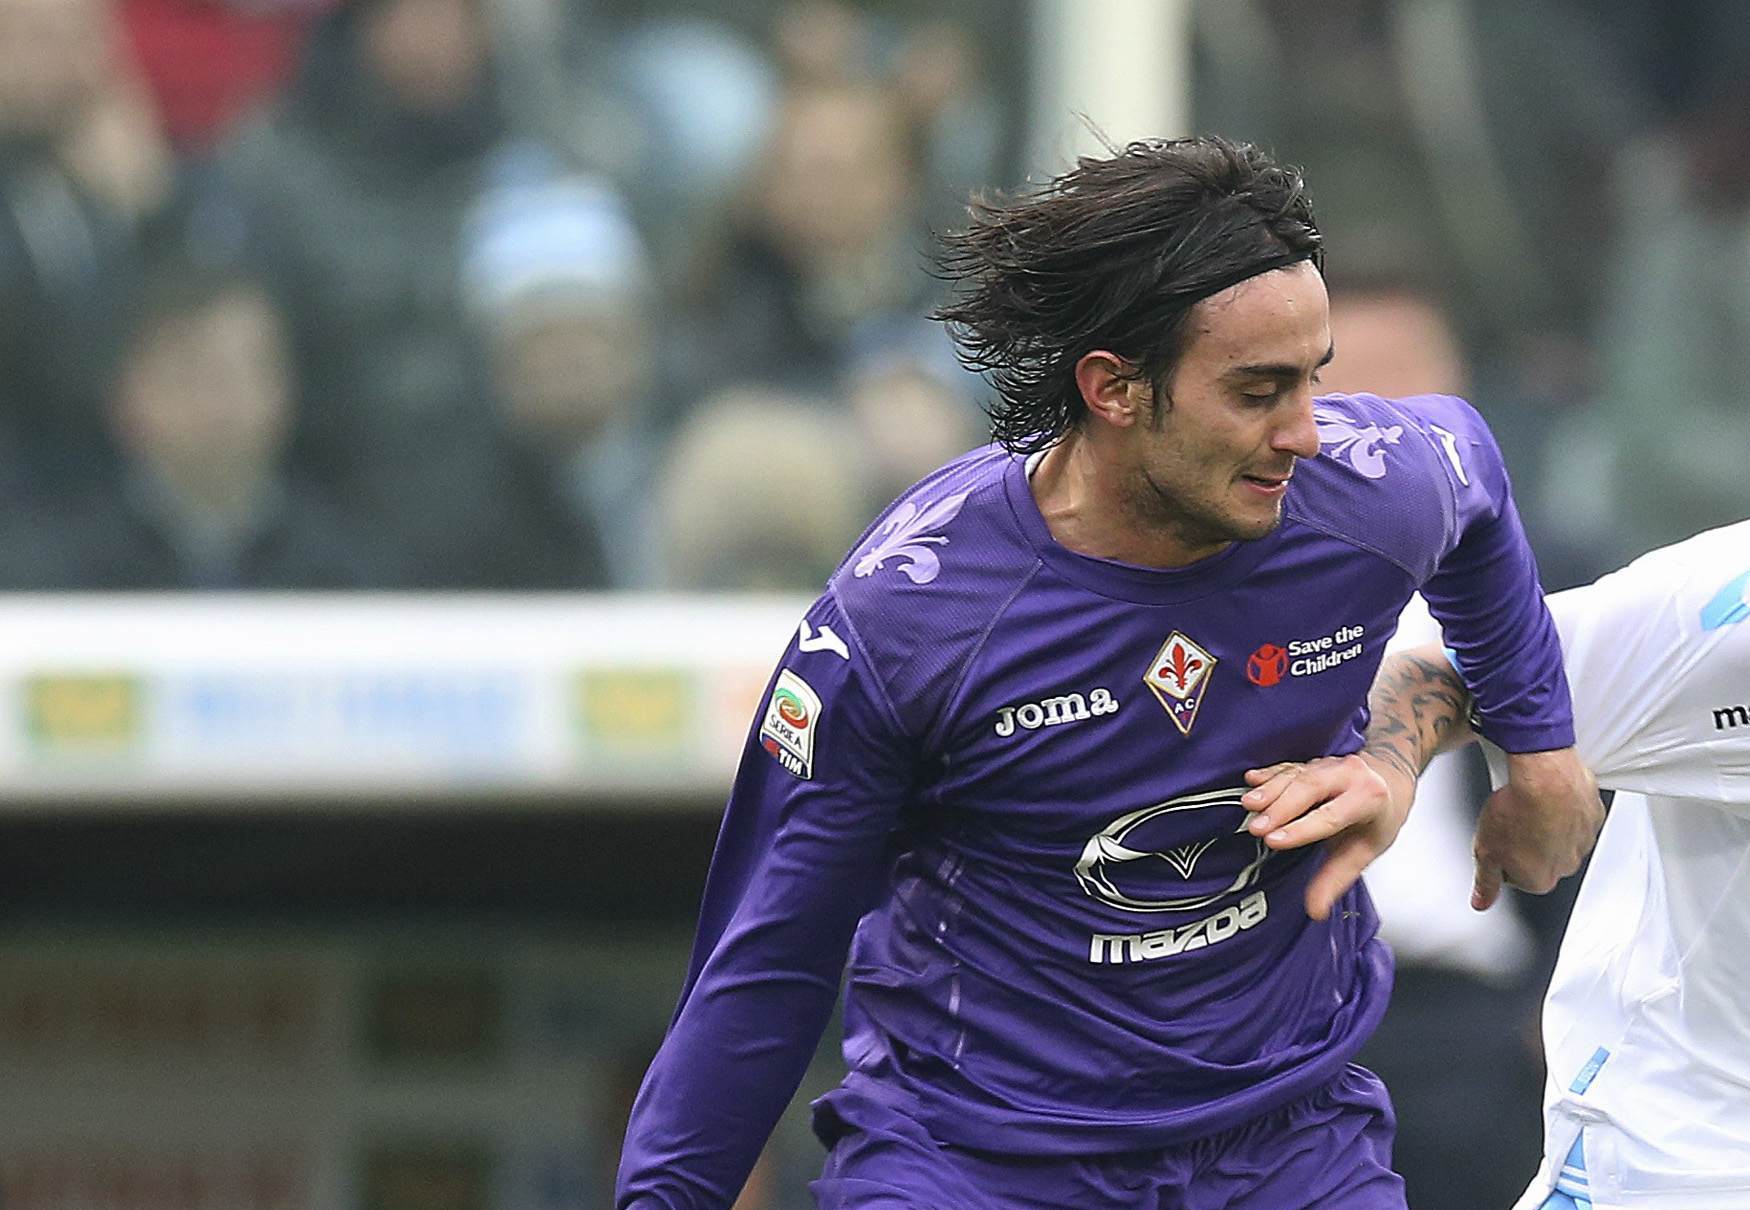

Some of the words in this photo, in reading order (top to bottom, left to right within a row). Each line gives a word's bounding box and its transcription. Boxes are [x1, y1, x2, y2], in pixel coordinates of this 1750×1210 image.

[1288, 637, 1332, 657] Save
[1335, 625, 1364, 642] the
[1290, 644, 1363, 676] Children
[768, 714, 795, 741] SERIE
[995, 688, 1119, 737] Joma
[779, 748, 803, 775] TIM
